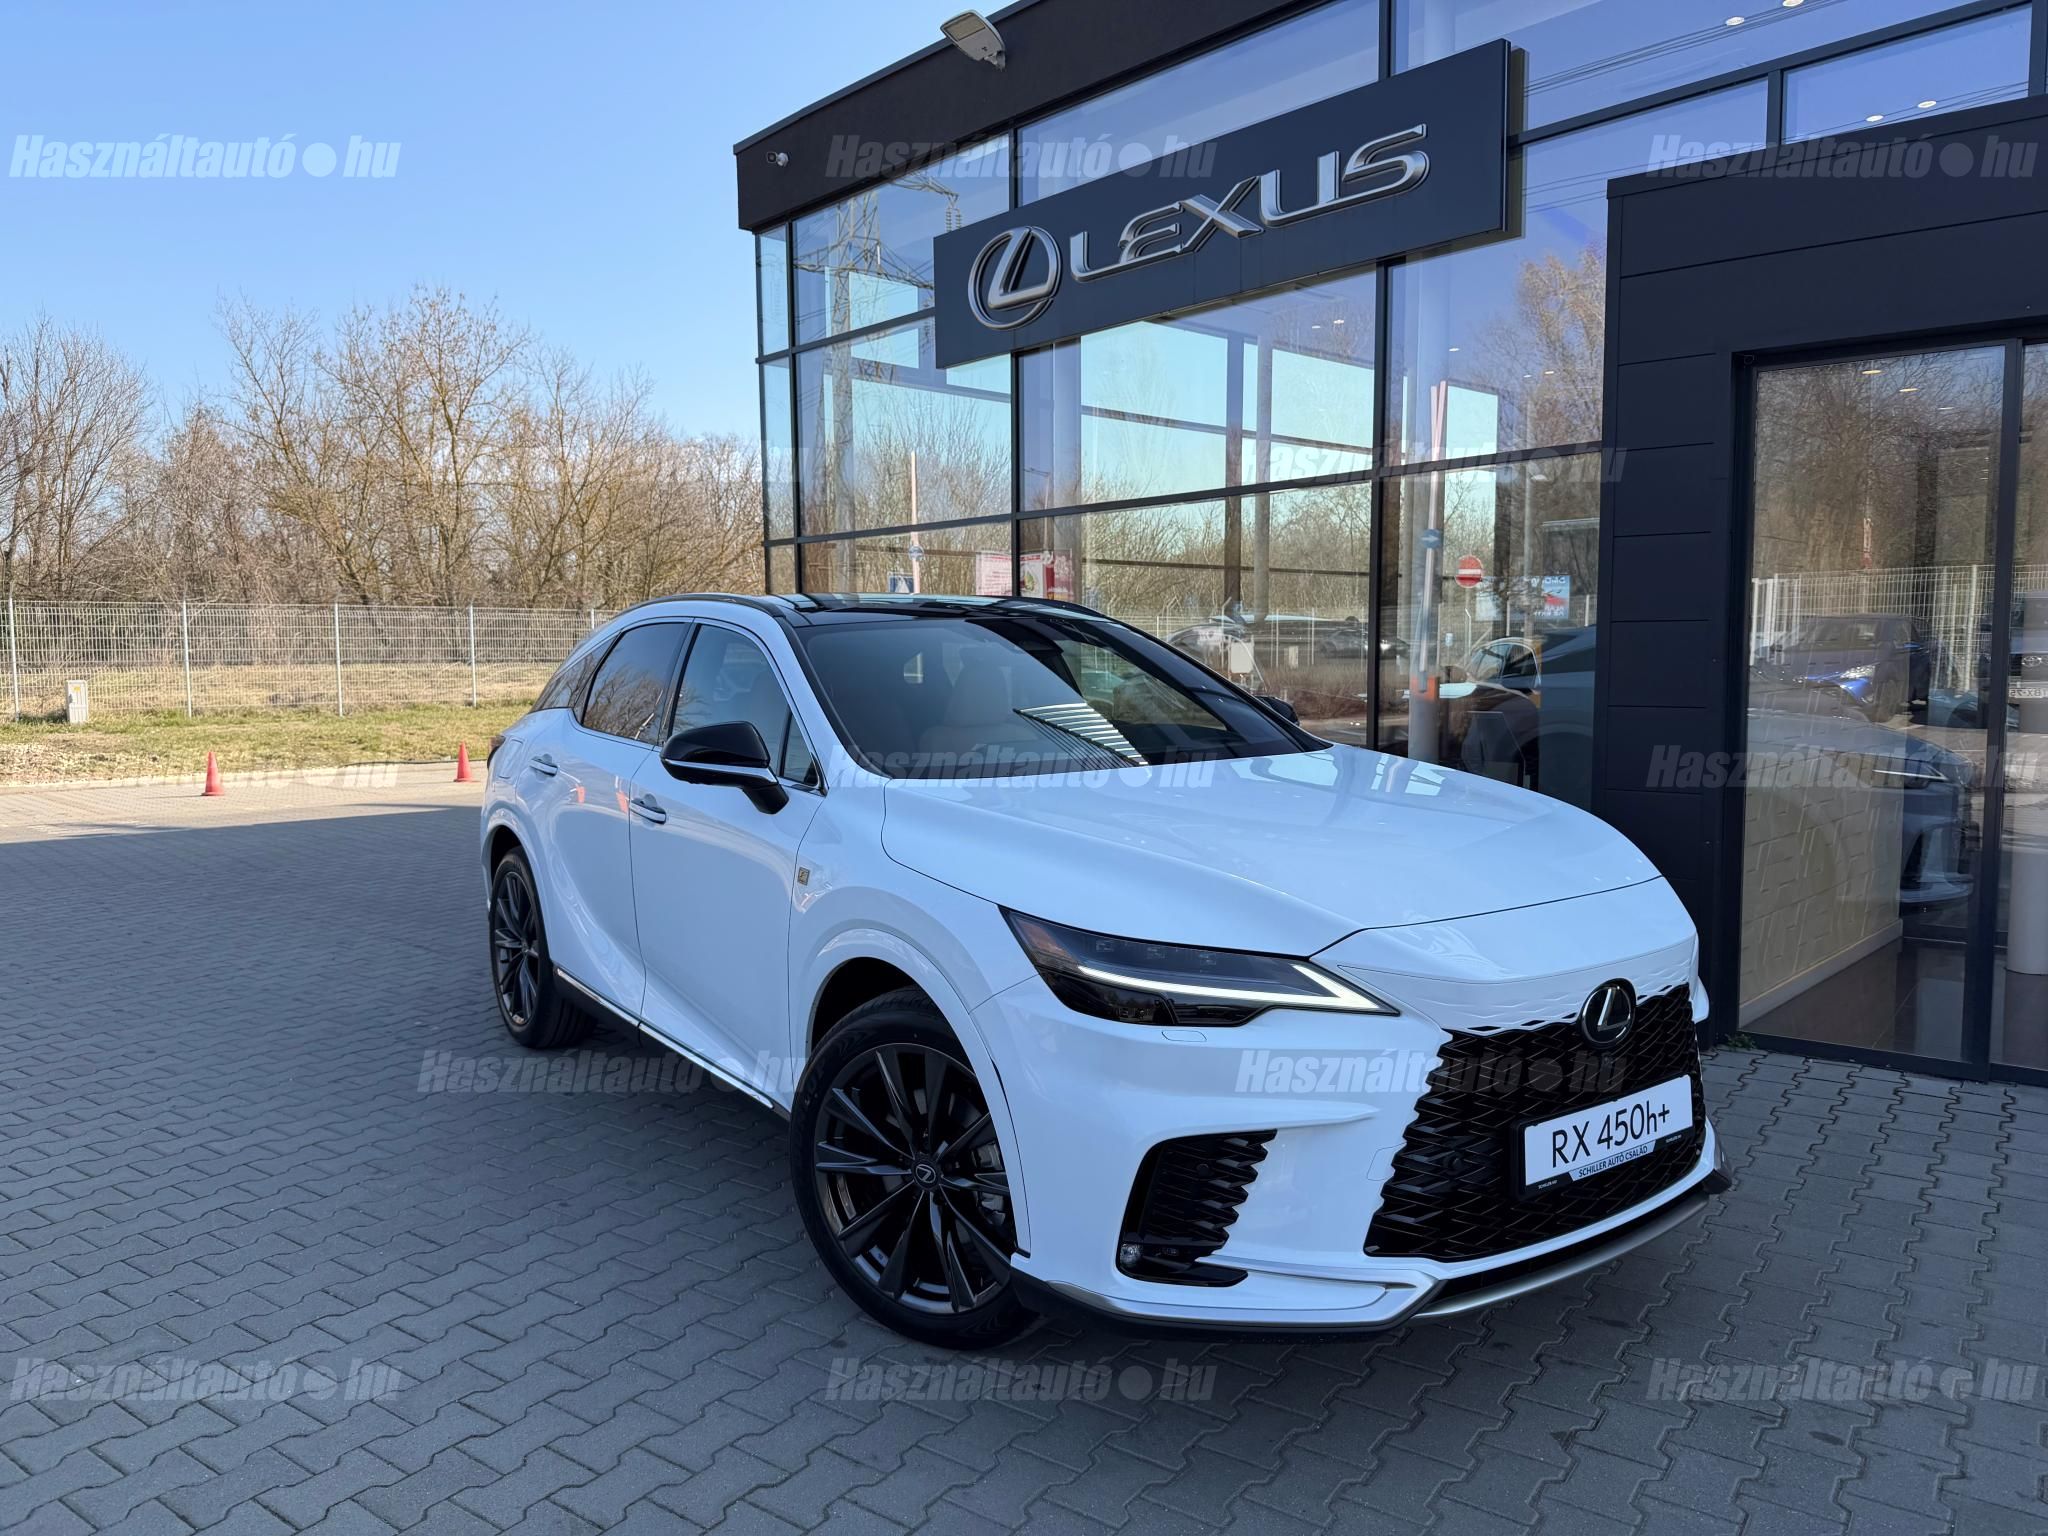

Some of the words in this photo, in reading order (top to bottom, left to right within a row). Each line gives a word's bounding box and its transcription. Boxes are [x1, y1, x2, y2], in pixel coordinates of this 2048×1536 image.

[1069, 123, 1430, 283] LEXUS
[1552, 1121, 1591, 1168] RX
[1597, 1100, 1670, 1150] 450h+
[1578, 1160, 1607, 1178] SCHILLER
[1607, 1152, 1625, 1167] AUTÓ
[1625, 1145, 1648, 1160] CSALÁD
